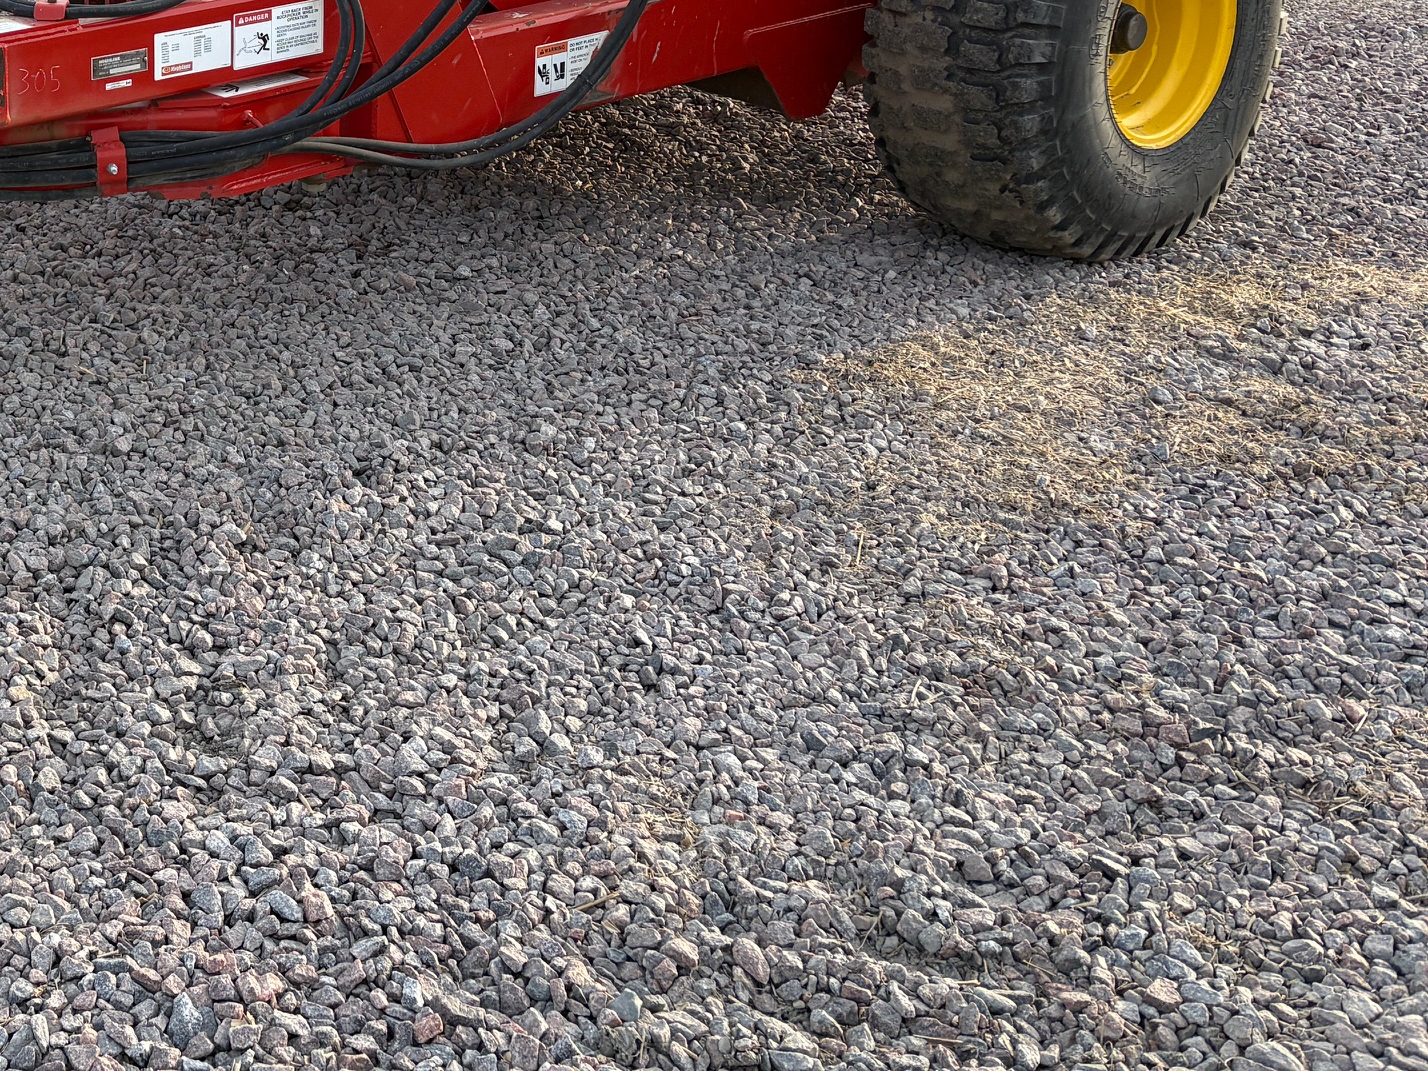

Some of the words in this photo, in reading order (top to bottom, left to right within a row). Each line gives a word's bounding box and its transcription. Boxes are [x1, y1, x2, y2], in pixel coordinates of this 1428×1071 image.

[244, 13, 269, 23] DANGER
[545, 44, 566, 53] WARNING
[17, 65, 61, 95] 305
